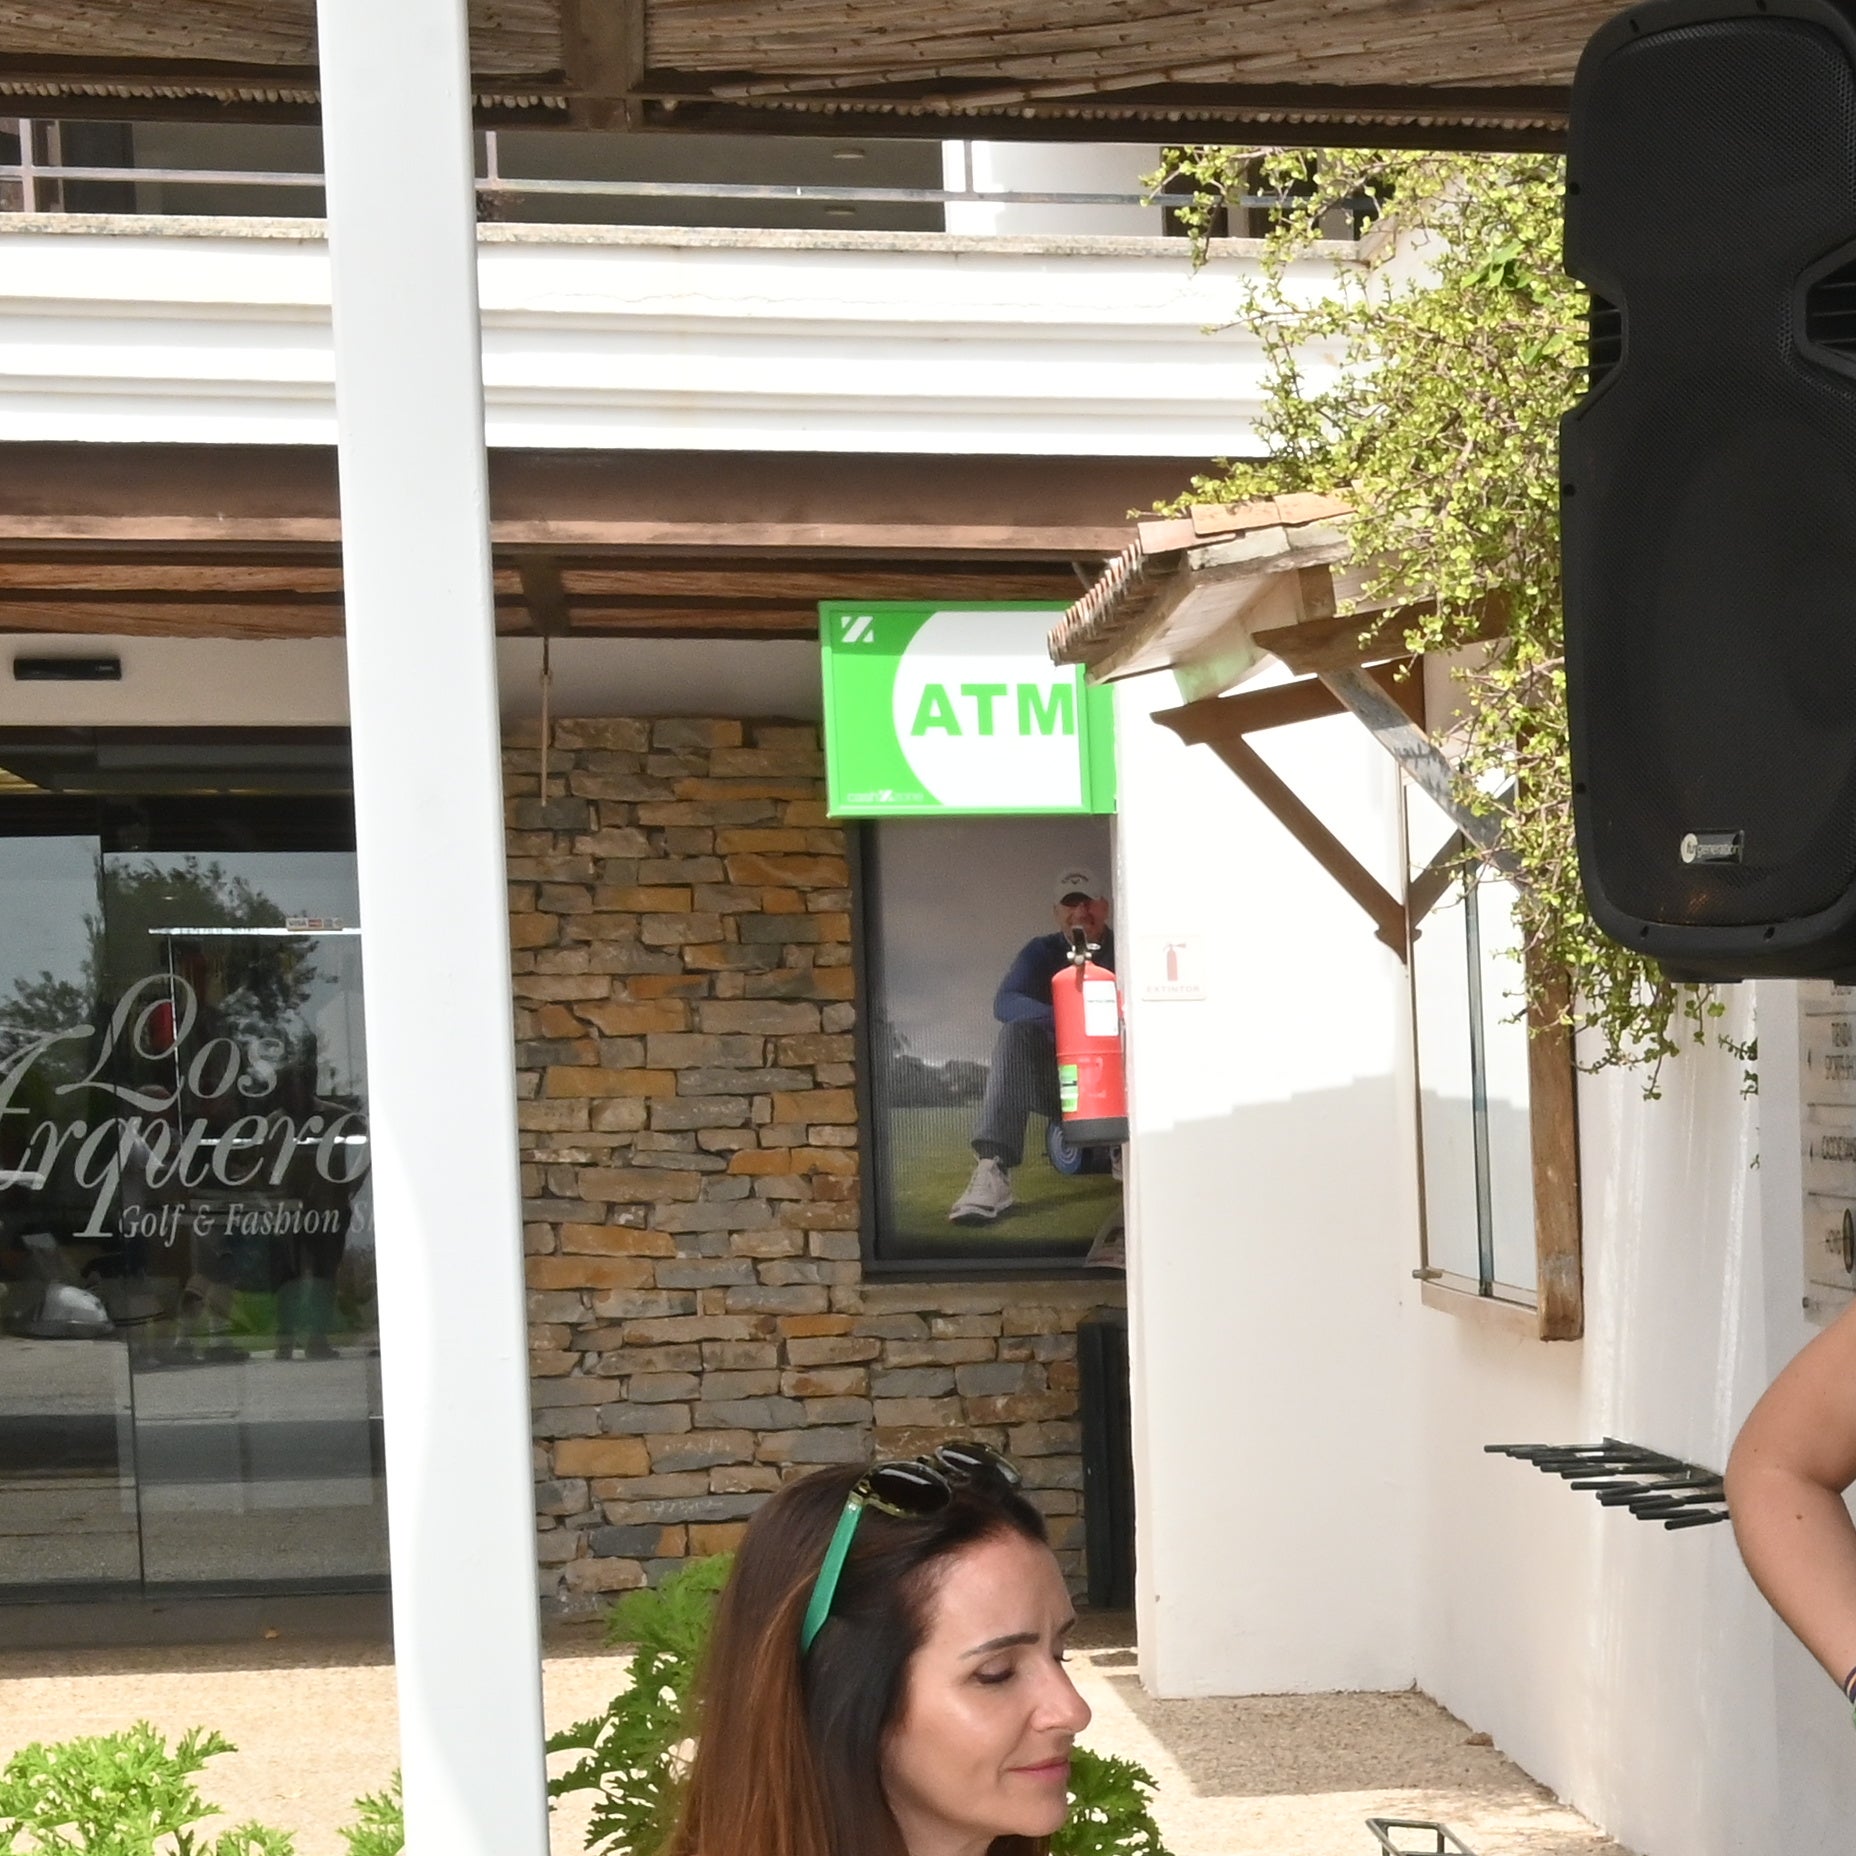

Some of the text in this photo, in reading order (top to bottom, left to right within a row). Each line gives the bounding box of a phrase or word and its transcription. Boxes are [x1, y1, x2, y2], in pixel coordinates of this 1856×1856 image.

[910, 683, 1075, 737] ATM
[55, 973, 285, 1112] Los
[122, 1203, 187, 1248] Golf
[193, 1209, 215, 1236] &
[224, 1200, 341, 1238] Fashion
